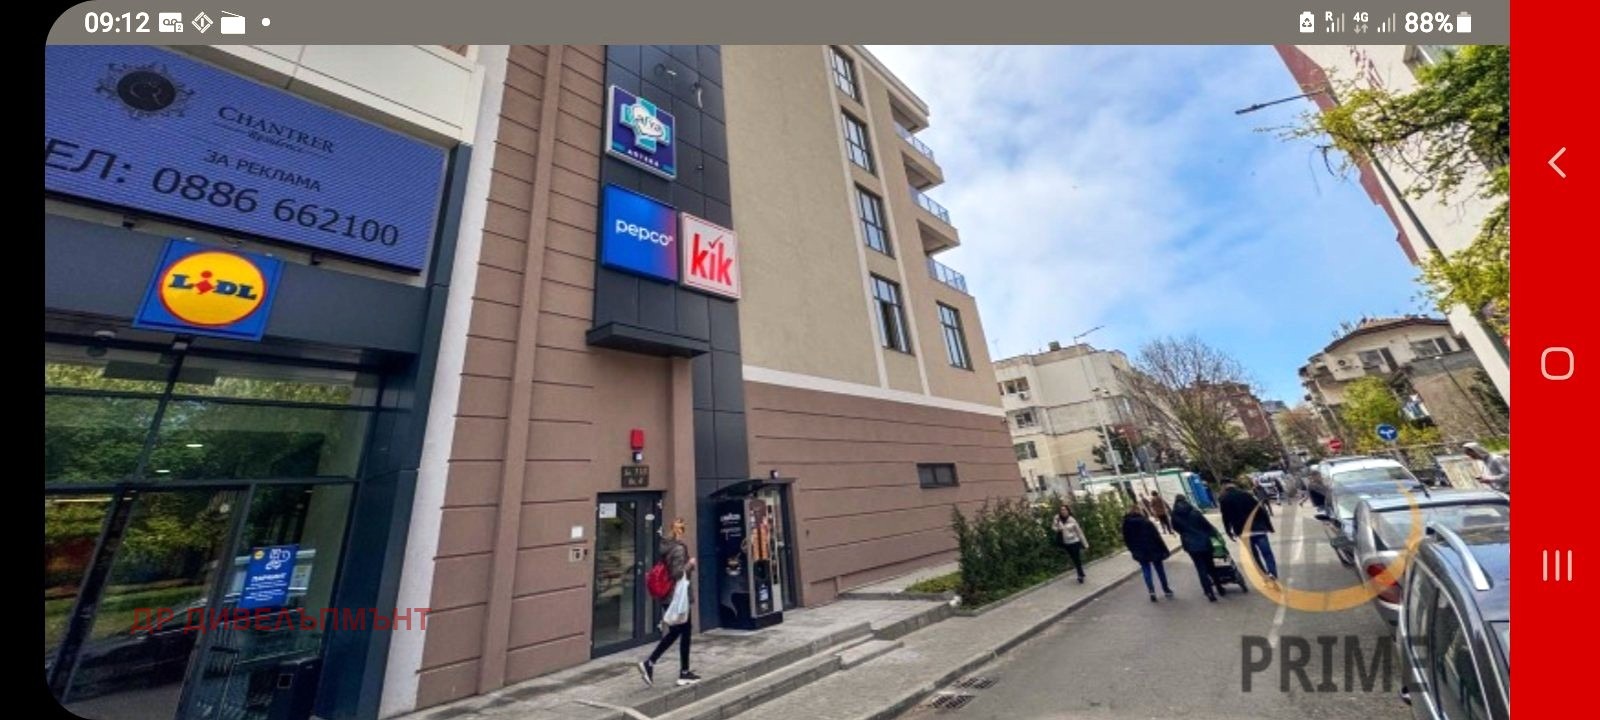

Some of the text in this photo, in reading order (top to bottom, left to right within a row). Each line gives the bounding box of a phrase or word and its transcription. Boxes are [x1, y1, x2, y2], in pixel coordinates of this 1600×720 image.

[218, 106, 334, 153] CHANTRER
[203, 149, 321, 192] ЗА РЕКЛАМА
[152, 167, 258, 213] 0886
[273, 198, 398, 246] 662100
[615, 219, 670, 246] pepco
[691, 234, 733, 286] kik
